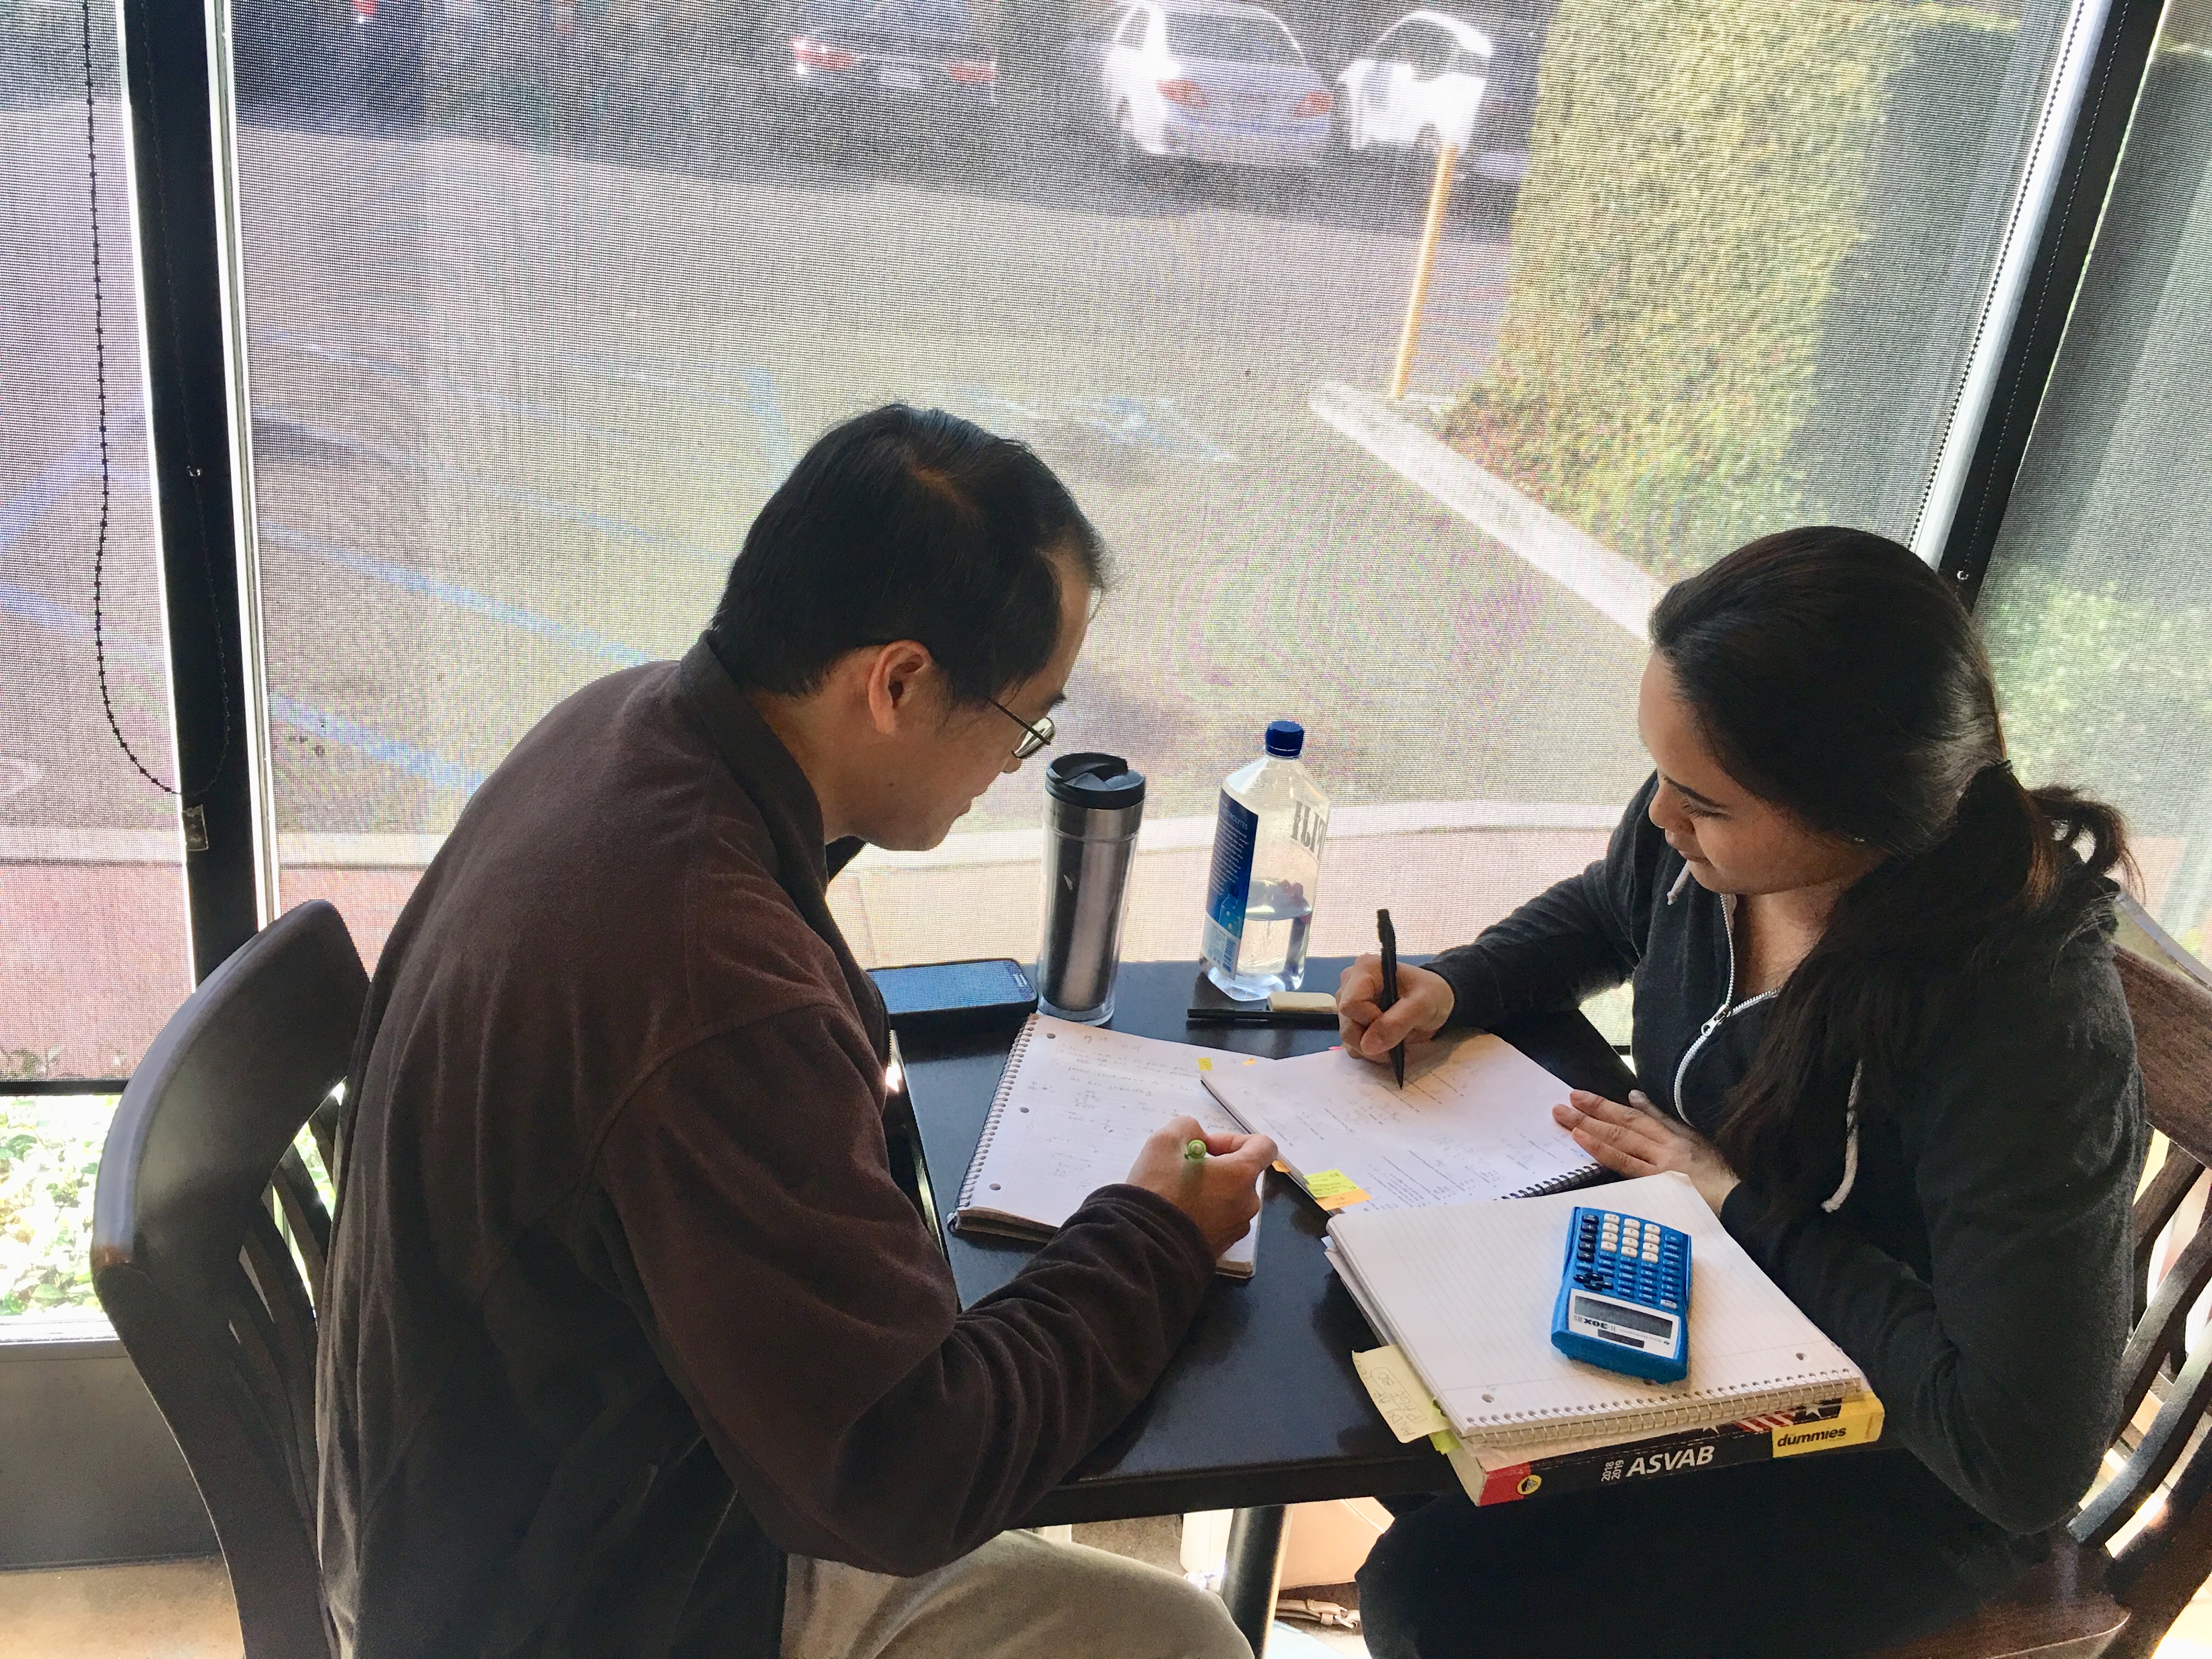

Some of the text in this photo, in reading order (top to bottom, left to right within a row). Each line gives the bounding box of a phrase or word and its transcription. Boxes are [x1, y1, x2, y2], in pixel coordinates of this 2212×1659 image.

[1584, 1318, 1616, 1331] TI-30X
[1393, 1390, 1422, 1421] PAGE
[1386, 1408, 1415, 1436] ANDY
[1777, 1427, 1847, 1447] dummies
[1601, 1461, 1614, 1482] 2018
[1611, 1460, 1624, 1480] 2019
[1626, 1446, 1715, 1477] ASVAB
